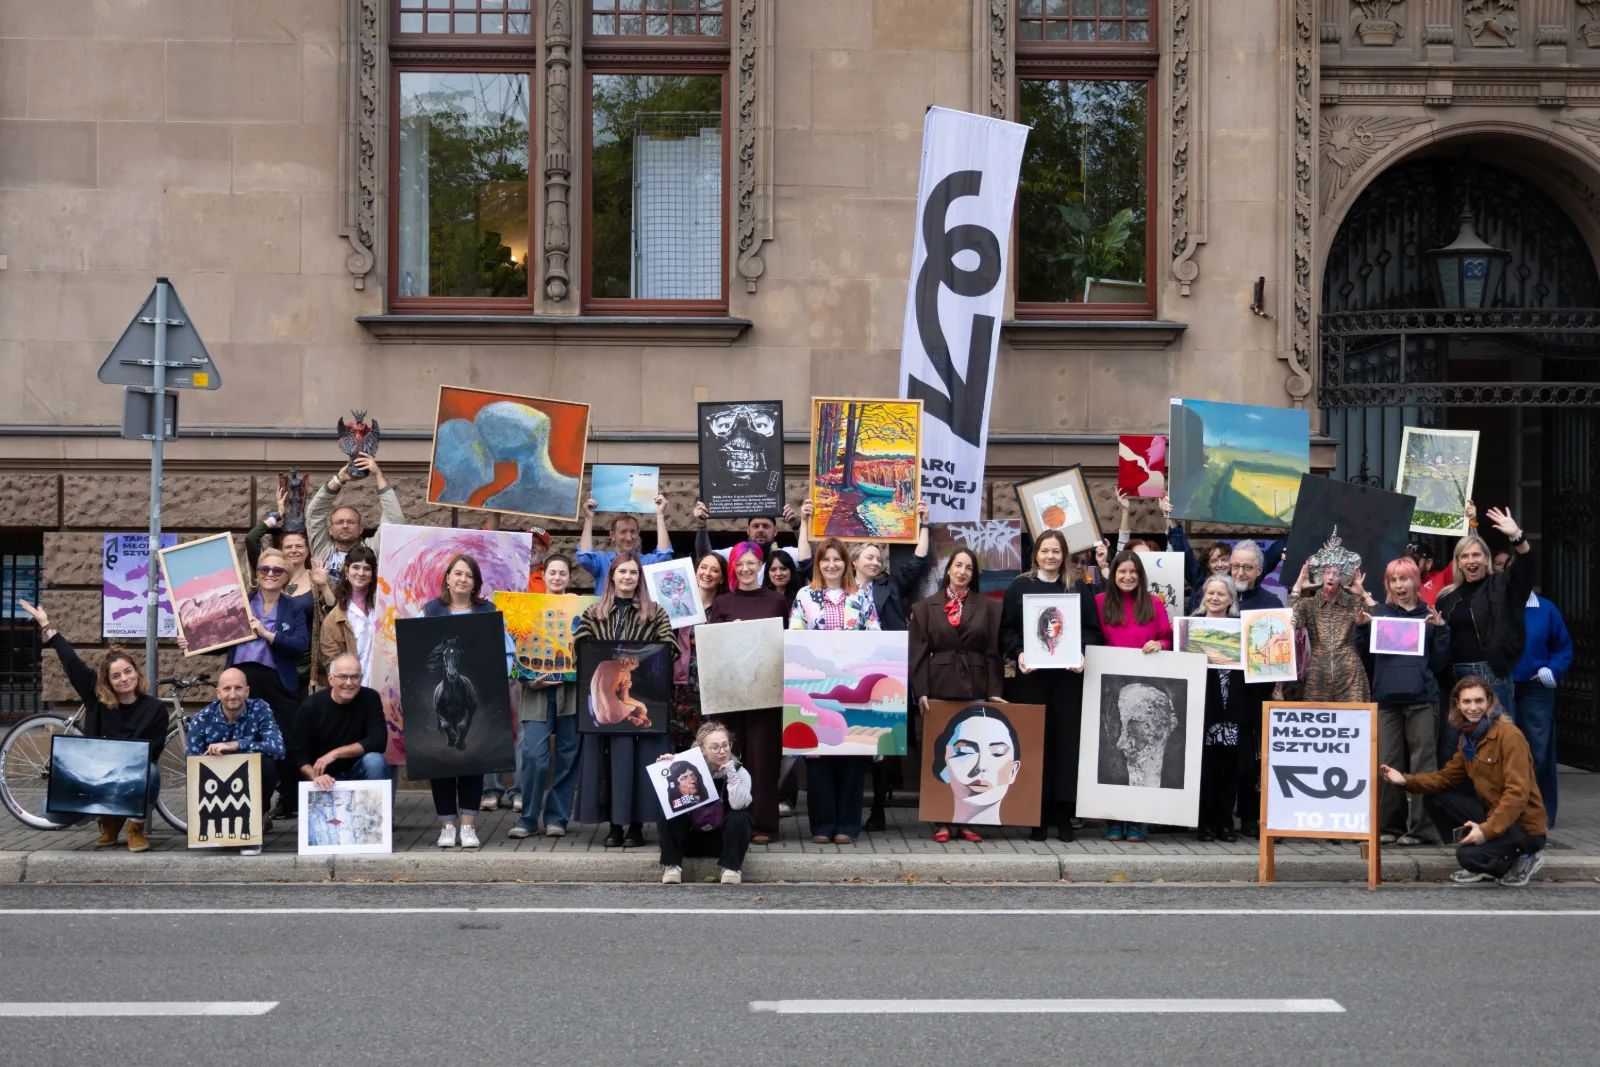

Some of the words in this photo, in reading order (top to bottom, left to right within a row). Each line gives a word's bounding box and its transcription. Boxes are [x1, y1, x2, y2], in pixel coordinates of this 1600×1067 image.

[1273, 712, 1336, 723] TARGI
[1272, 726, 1360, 739] MŁODEJ
[1272, 741, 1350, 753] SZTUKI
[1293, 811, 1324, 829] TO
[1329, 812, 1367, 830] TU!
